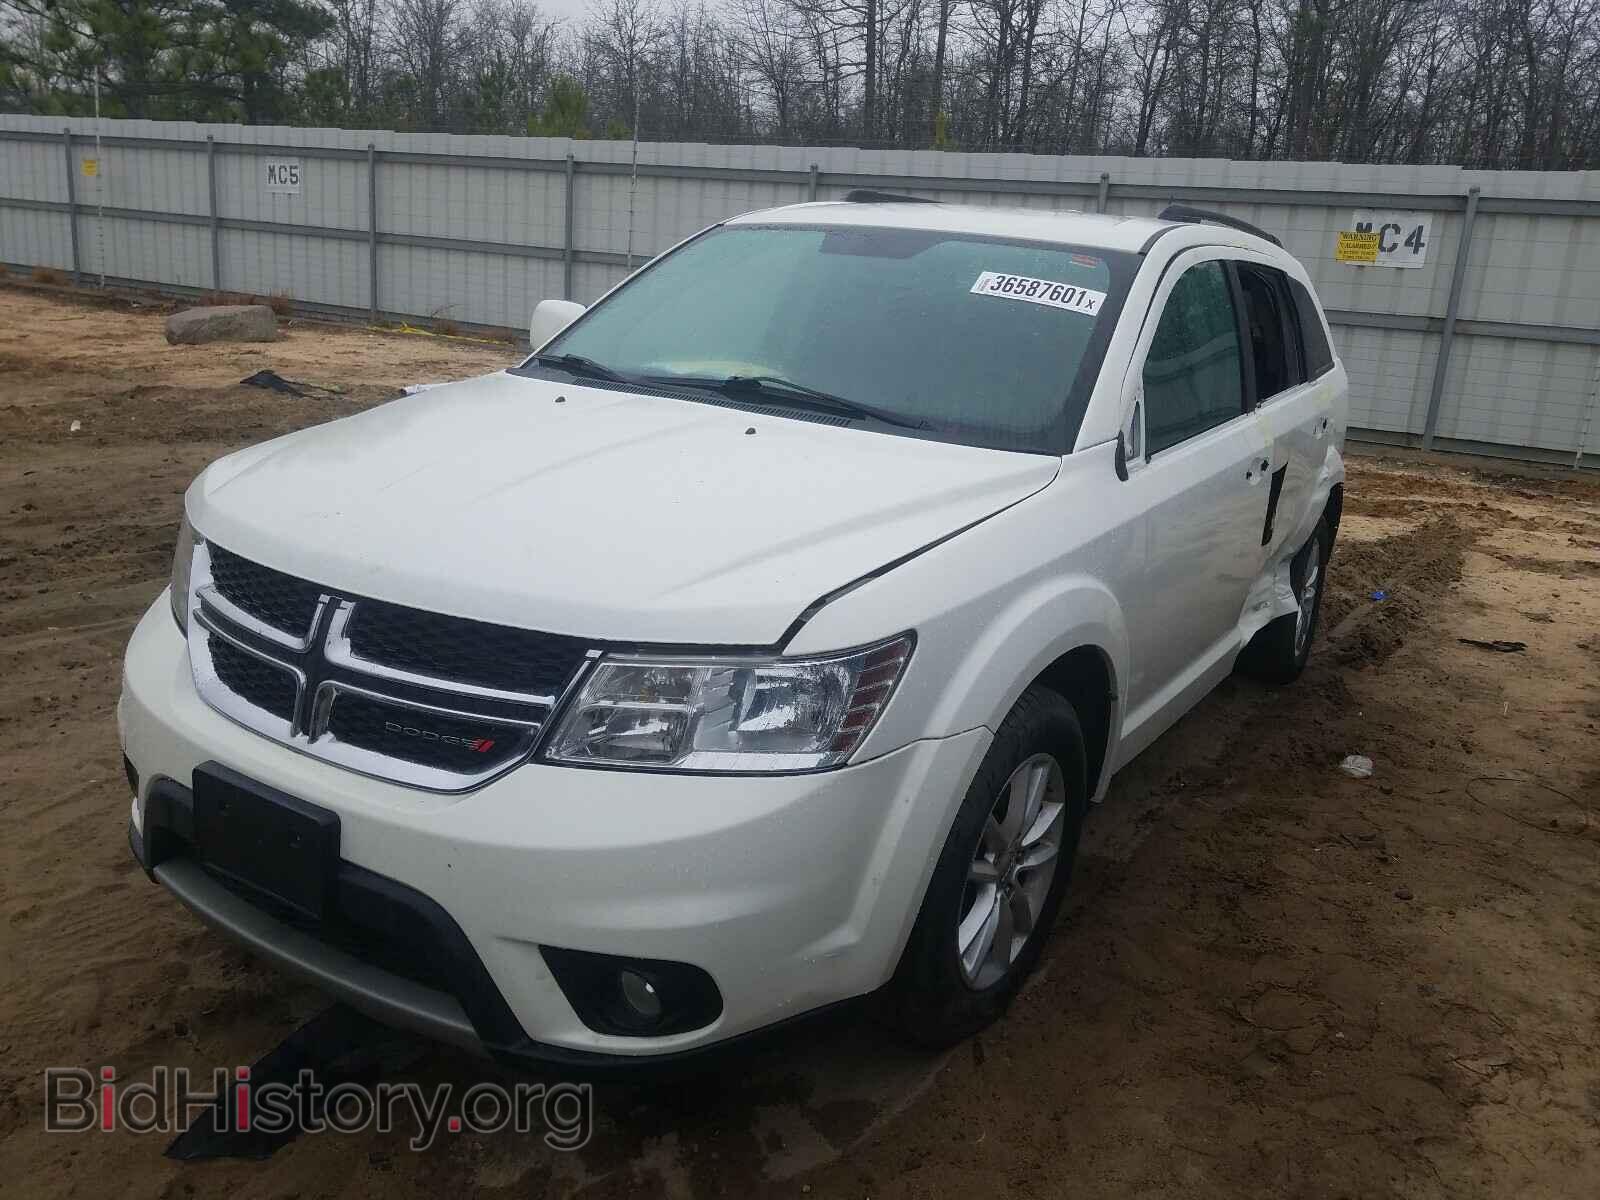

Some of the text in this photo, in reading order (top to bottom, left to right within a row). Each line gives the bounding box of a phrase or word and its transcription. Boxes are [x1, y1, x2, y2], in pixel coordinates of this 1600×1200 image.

[267, 164, 299, 185] MC5
[1342, 232, 1377, 241] WARNING
[385, 721, 480, 751] DODGE
